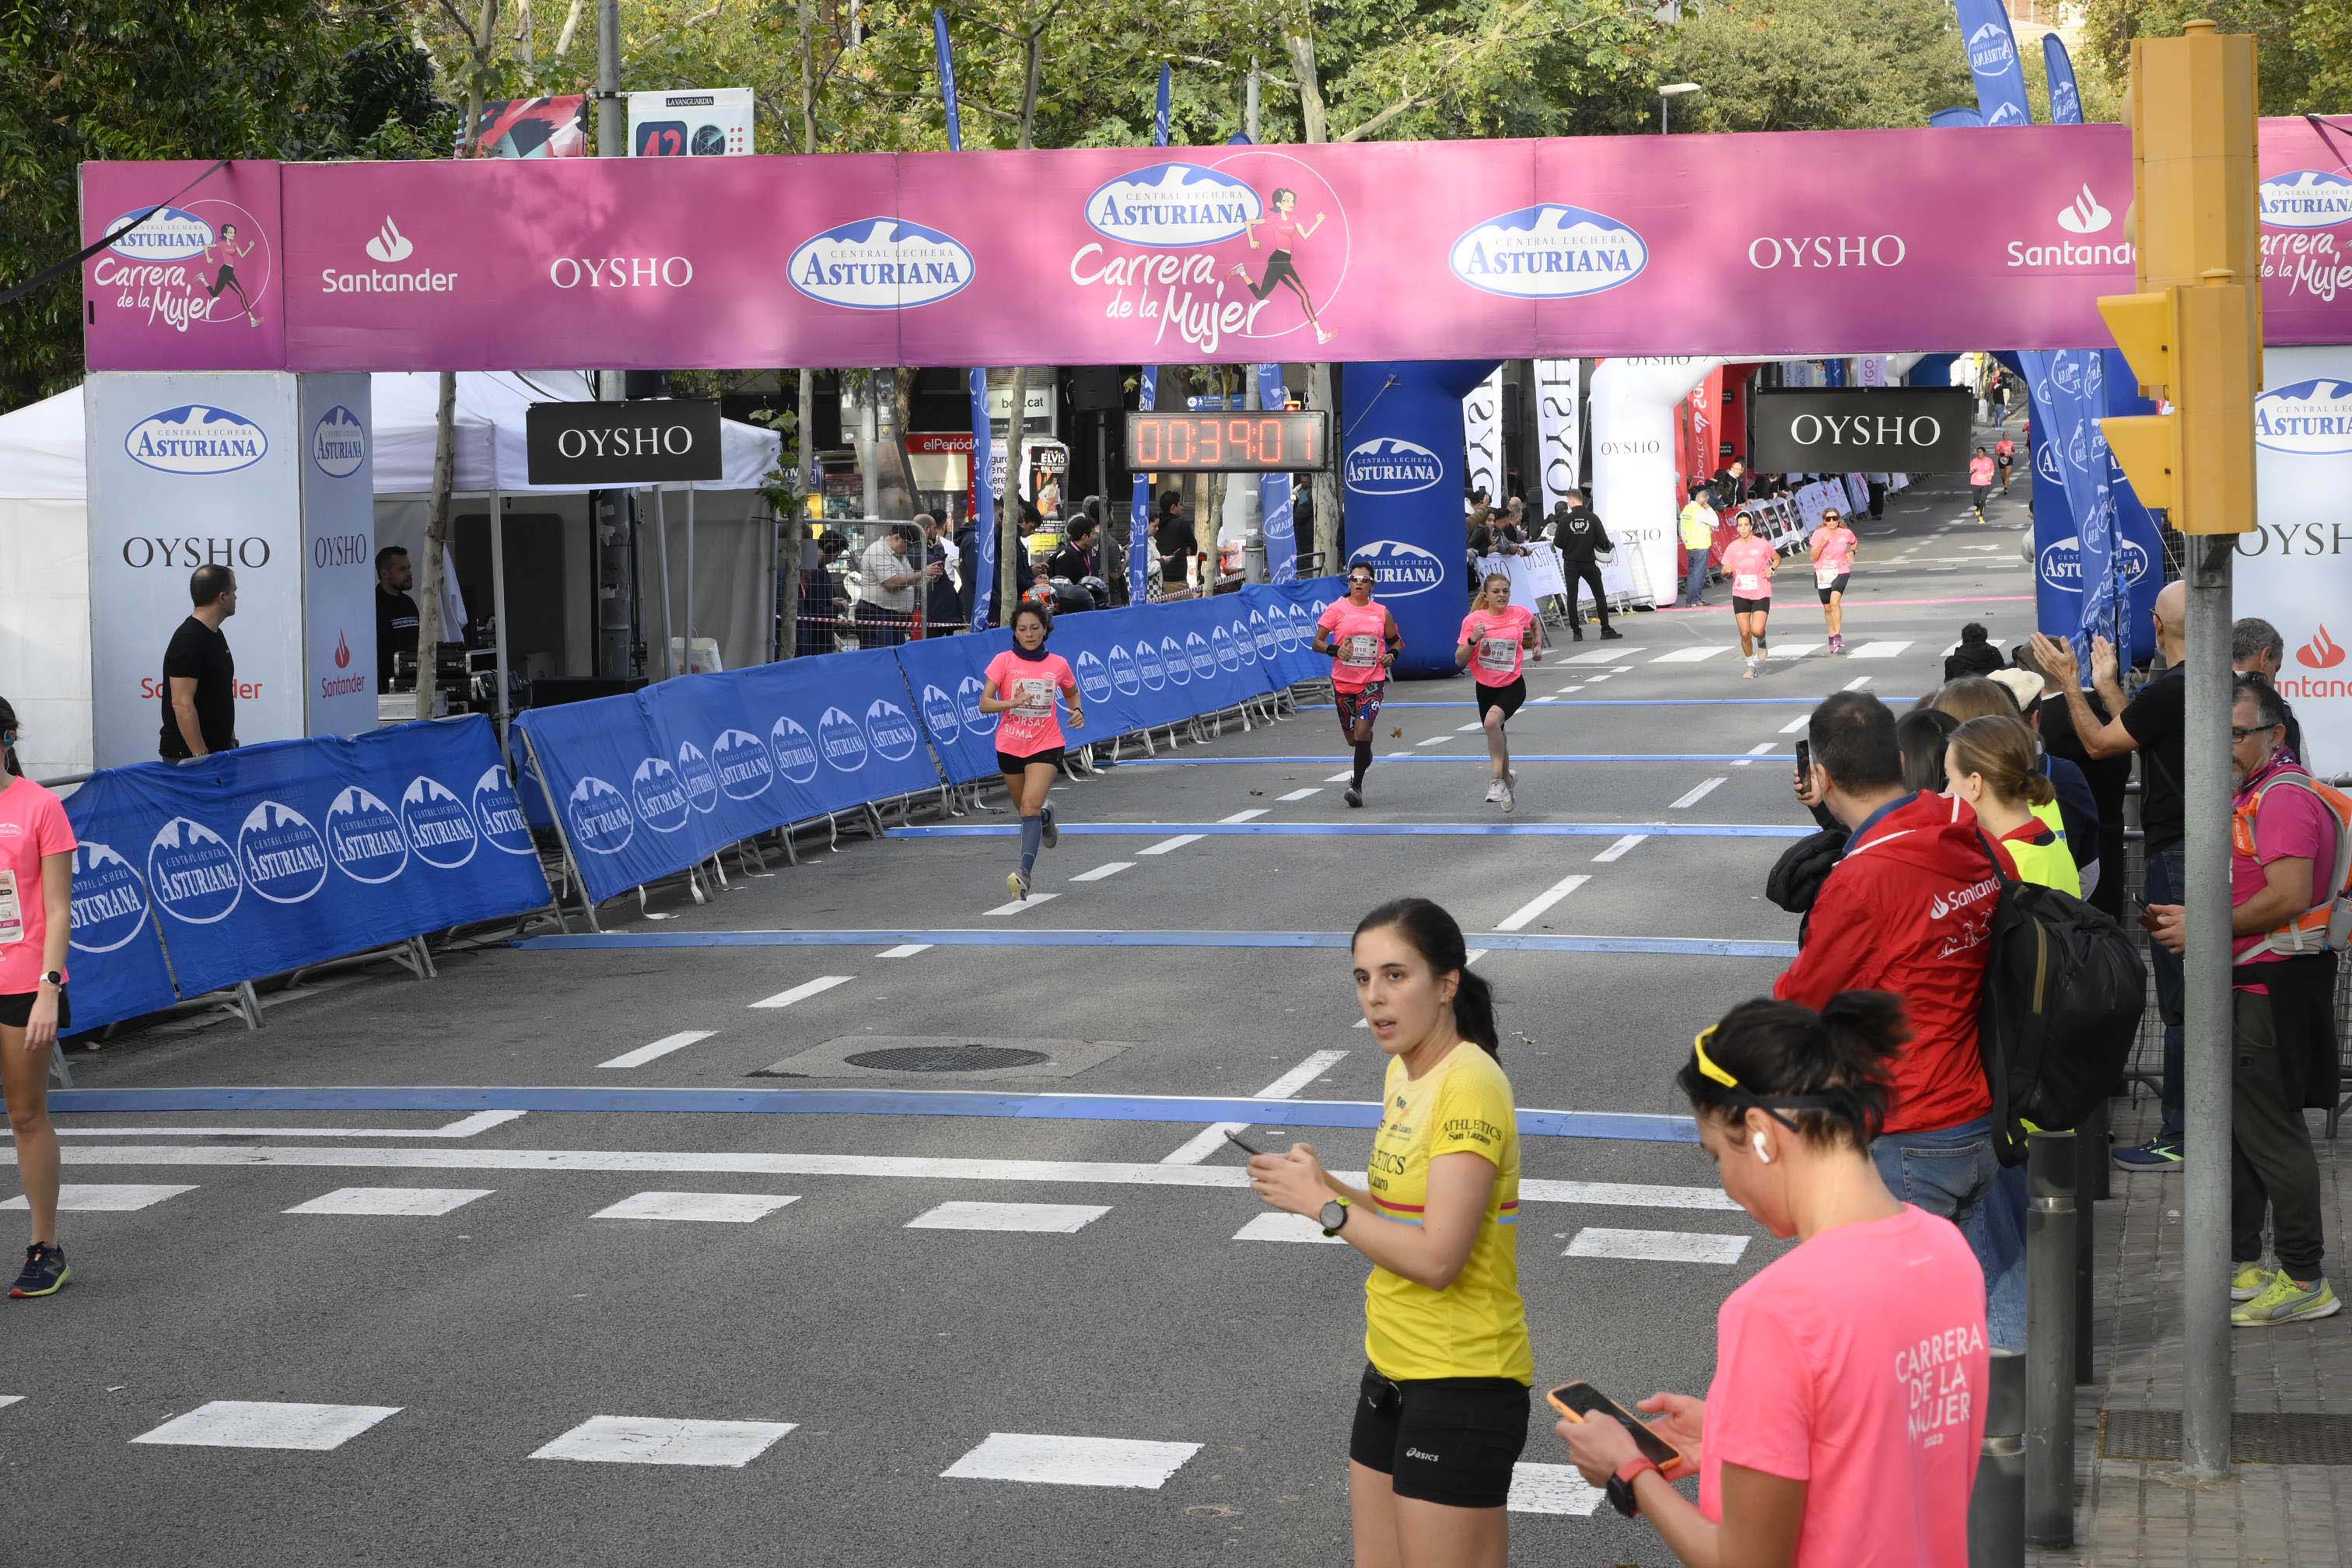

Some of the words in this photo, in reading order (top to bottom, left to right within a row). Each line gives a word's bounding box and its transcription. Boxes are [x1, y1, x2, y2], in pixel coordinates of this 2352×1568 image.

[1099, 194, 1248, 226] ASTURIANA
[1125, 192, 1181, 201] CENTRAL
[1187, 191, 1244, 200] LECHERA
[113, 226, 206, 247] ASTURIANA
[1495, 236, 1556, 247] CENTRAL
[1563, 236, 1626, 245] LECHERA
[2260, 233, 2335, 255] arrera
[830, 250, 889, 258] CENTRAL
[895, 249, 954, 258] LECHERA
[1070, 243, 1217, 286] Carrera
[1465, 240, 1633, 275] ASTURIANA
[1748, 234, 1906, 269] OYSHO
[2007, 241, 2135, 267] Santand
[94, 257, 186, 286] Carrera
[322, 268, 458, 293] Santander
[550, 257, 693, 289] OYSHO
[802, 251, 961, 286] ASTURIANA
[2279, 255, 2292, 277] la
[2289, 251, 2352, 302] Muje
[117, 289, 135, 308] de
[138, 288, 150, 308] la
[148, 283, 221, 332] Mujer
[1106, 288, 1134, 319] de
[1139, 289, 1158, 319] la
[1154, 281, 1270, 354] Mujer
[1790, 415, 1941, 446] OYSHO
[2256, 408, 2352, 437] ASTURI
[136, 431, 257, 457] ASTURIANA
[317, 432, 362, 460] ASTURIANA
[558, 425, 693, 458] OYSHO
[924, 438, 972, 451] elPeriód
[1601, 440, 1661, 456] OYSHO
[1041, 453, 1065, 464] ELVIS
[1348, 461, 1436, 482] ASTURIANA
[1623, 528, 1661, 543] SHO
[2237, 523, 2352, 557] OYSH
[123, 537, 271, 569] OYSHO
[315, 534, 366, 569] OYSHO
[1374, 568, 1437, 583] URIANA
[322, 673, 366, 698] Santander
[822, 733, 866, 758] ASTURIANA
[1004, 723, 1033, 739] SUMA
[775, 743, 816, 769] ASTURIANA
[716, 756, 772, 786] ASTURIANA
[341, 819, 366, 831] CENTRAL
[408, 814, 474, 849] ASTURIANA
[481, 802, 527, 836] ASTUR
[284, 830, 312, 844] LECHERA
[334, 826, 404, 863] ASTURIANA
[246, 844, 324, 883] ASTURIANA
[158, 861, 239, 902] ASTURIANA
[1948, 872, 2002, 911] Santand
[70, 884, 143, 929] STURIANA
[1444, 1119, 1502, 1142] ATHLETICS
[1448, 1132, 1464, 1140] San
[1895, 1323, 1983, 1383] CARRERA
[1909, 1371, 1933, 1410] DE
[1940, 1360, 1967, 1395] LA
[1908, 1392, 1971, 1441] MUJER
